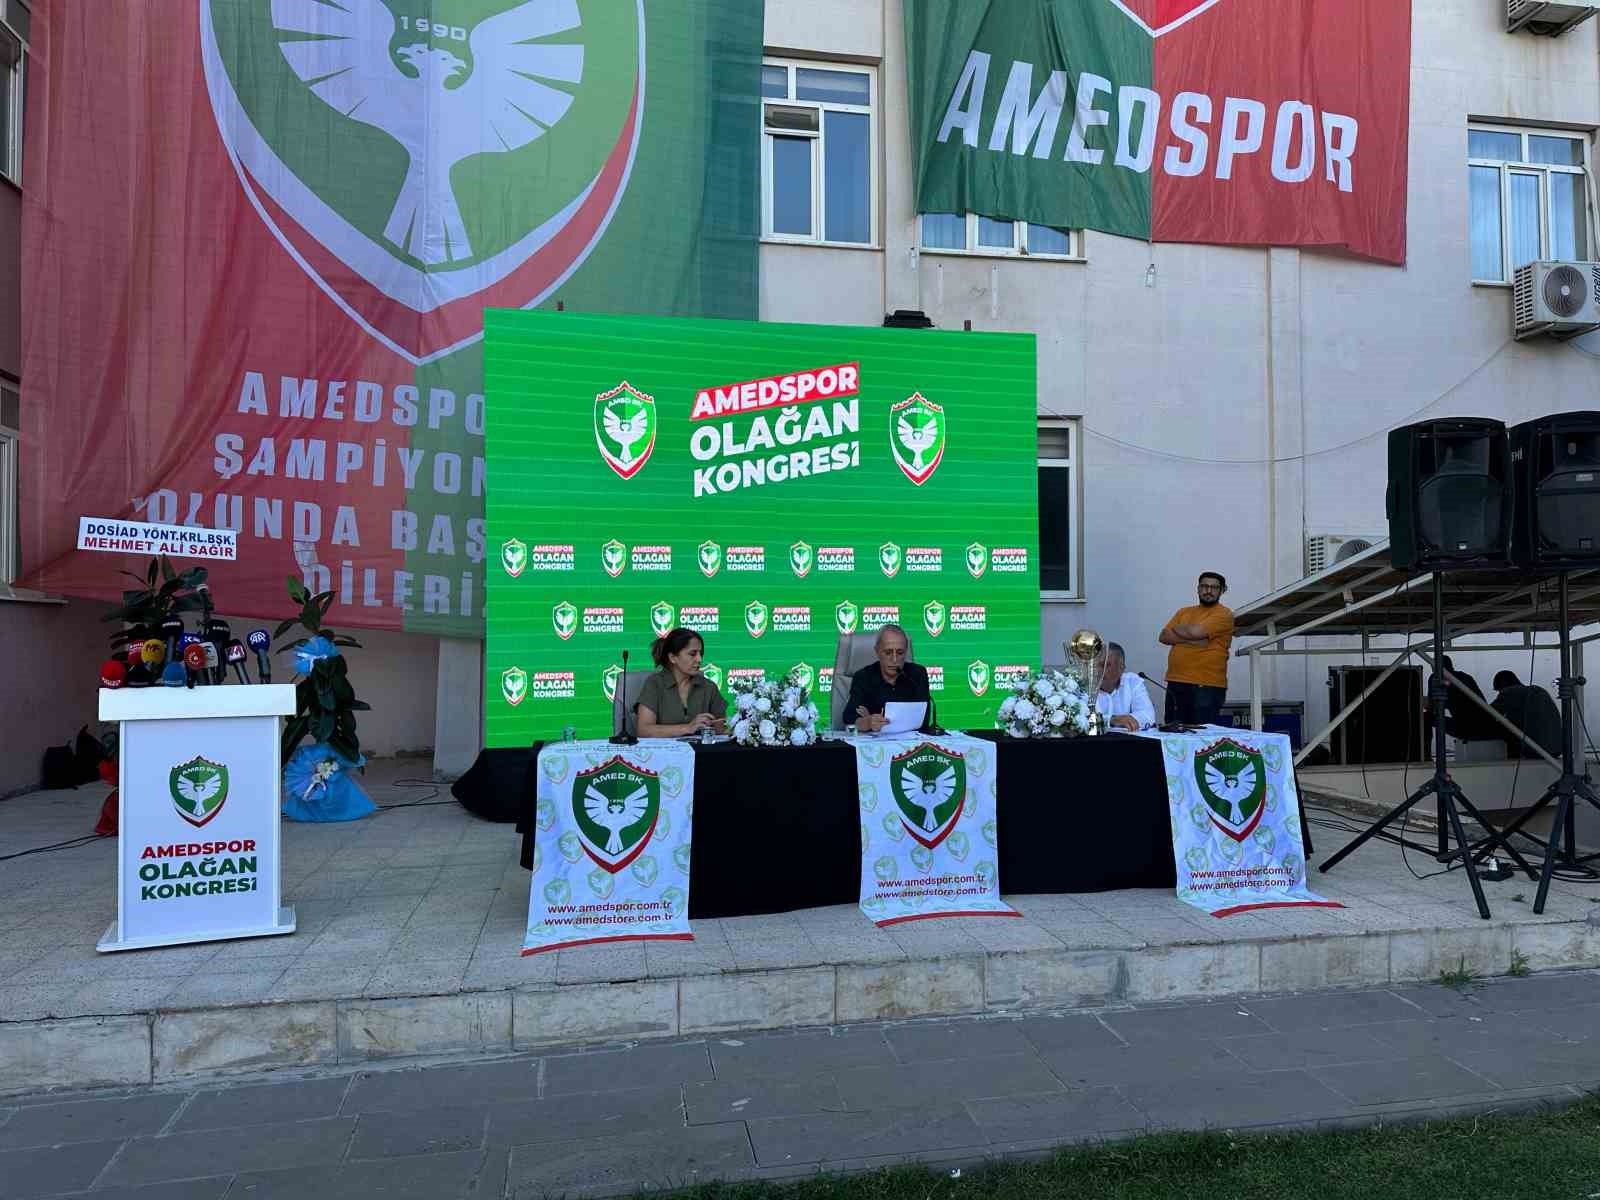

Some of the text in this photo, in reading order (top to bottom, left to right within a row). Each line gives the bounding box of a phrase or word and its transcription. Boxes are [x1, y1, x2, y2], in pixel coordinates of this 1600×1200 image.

[400, 15, 466, 41] 1990
[936, 49, 1359, 193] AMEDSPOR
[692, 365, 858, 419] AMEDSPOR
[690, 398, 860, 461] OLAĞAN
[693, 441, 860, 498] KONGRESİ
[86, 523, 235, 547] DOSİAD YÖNT.KRL.BŞK.
[84, 536, 234, 558] MEHMET ALİ SAĞIR
[302, 560, 486, 617] DİLERİ
[592, 772, 626, 786] AMED
[141, 839, 256, 859] AMEDSPOR
[139, 855, 257, 882] OLAĞAN
[1190, 866, 1293, 879] www.amedspor.com.tr
[141, 876, 257, 901] KONGRESİ
[878, 873, 986, 888] www.amedspor.com.tr
[1190, 878, 1296, 891] www.amedstore.com.tr
[875, 886, 988, 899] www.amedstore.com.tr
[547, 900, 672, 914] www.amedspor.com.tr
[544, 913, 673, 926] www.amedstore.com.tr
